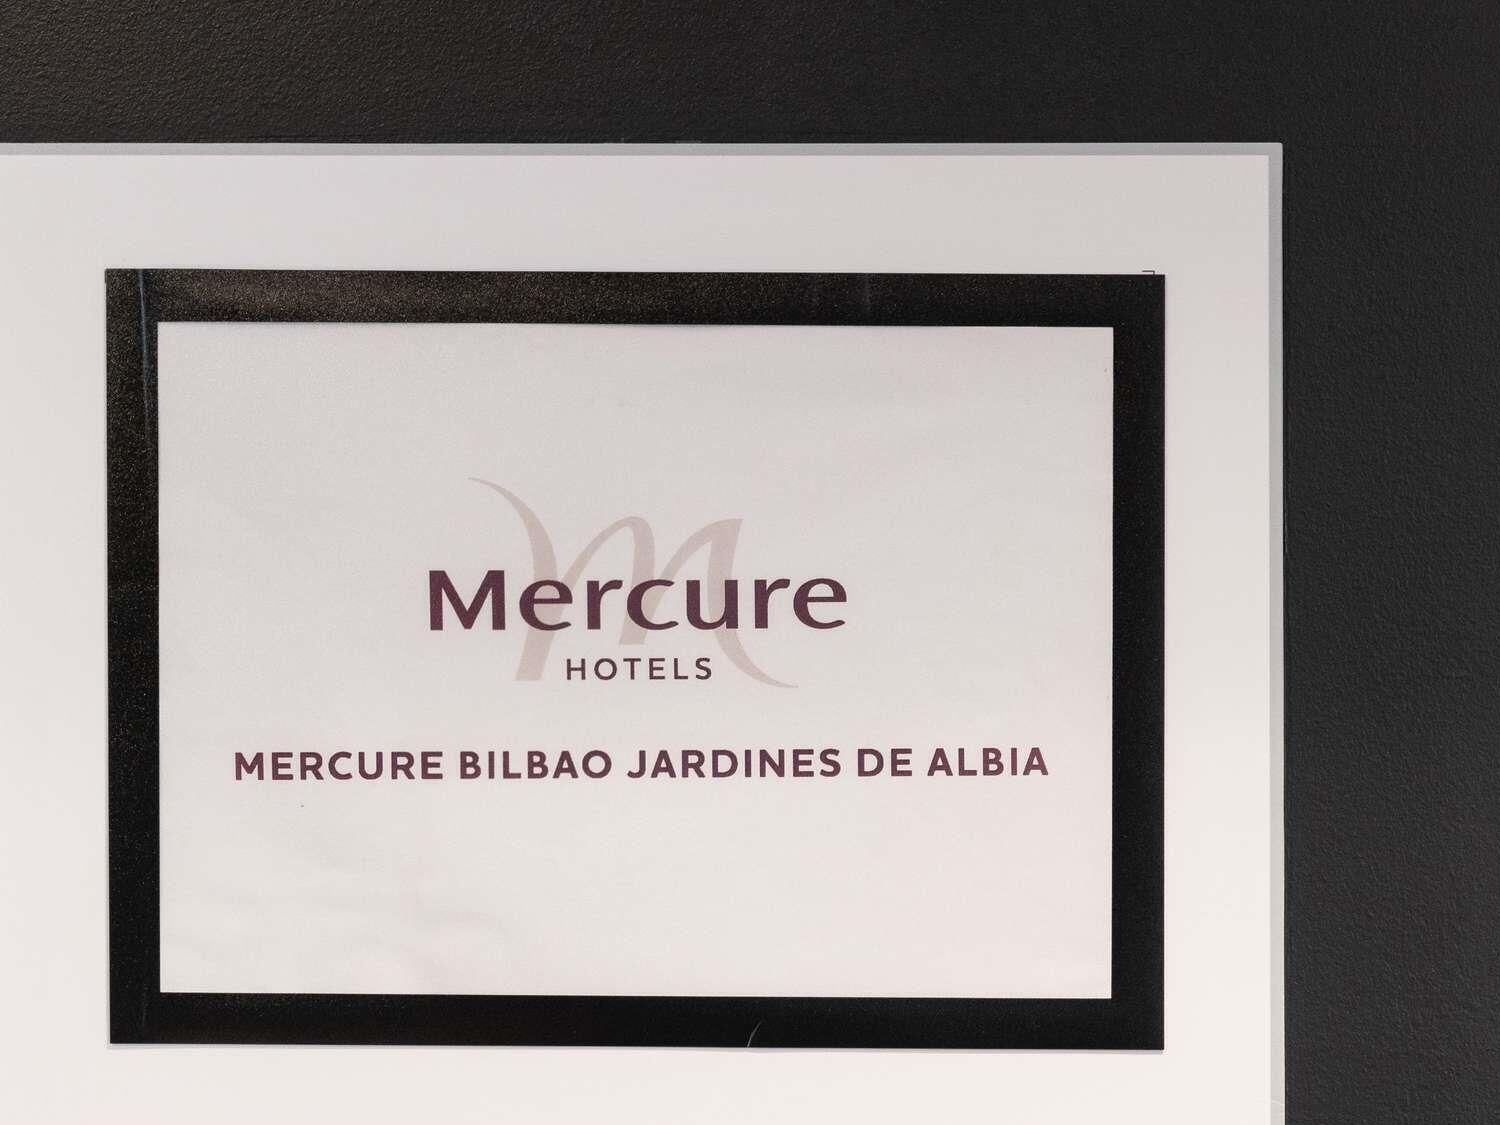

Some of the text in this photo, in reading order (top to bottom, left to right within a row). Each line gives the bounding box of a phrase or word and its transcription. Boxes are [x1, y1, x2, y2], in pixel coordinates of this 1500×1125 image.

[428, 569, 847, 632] Mercure
[565, 656, 713, 681] HOTELS
[234, 747, 1050, 781] MERCURE BILBAO JARDINES DE ALBIA
